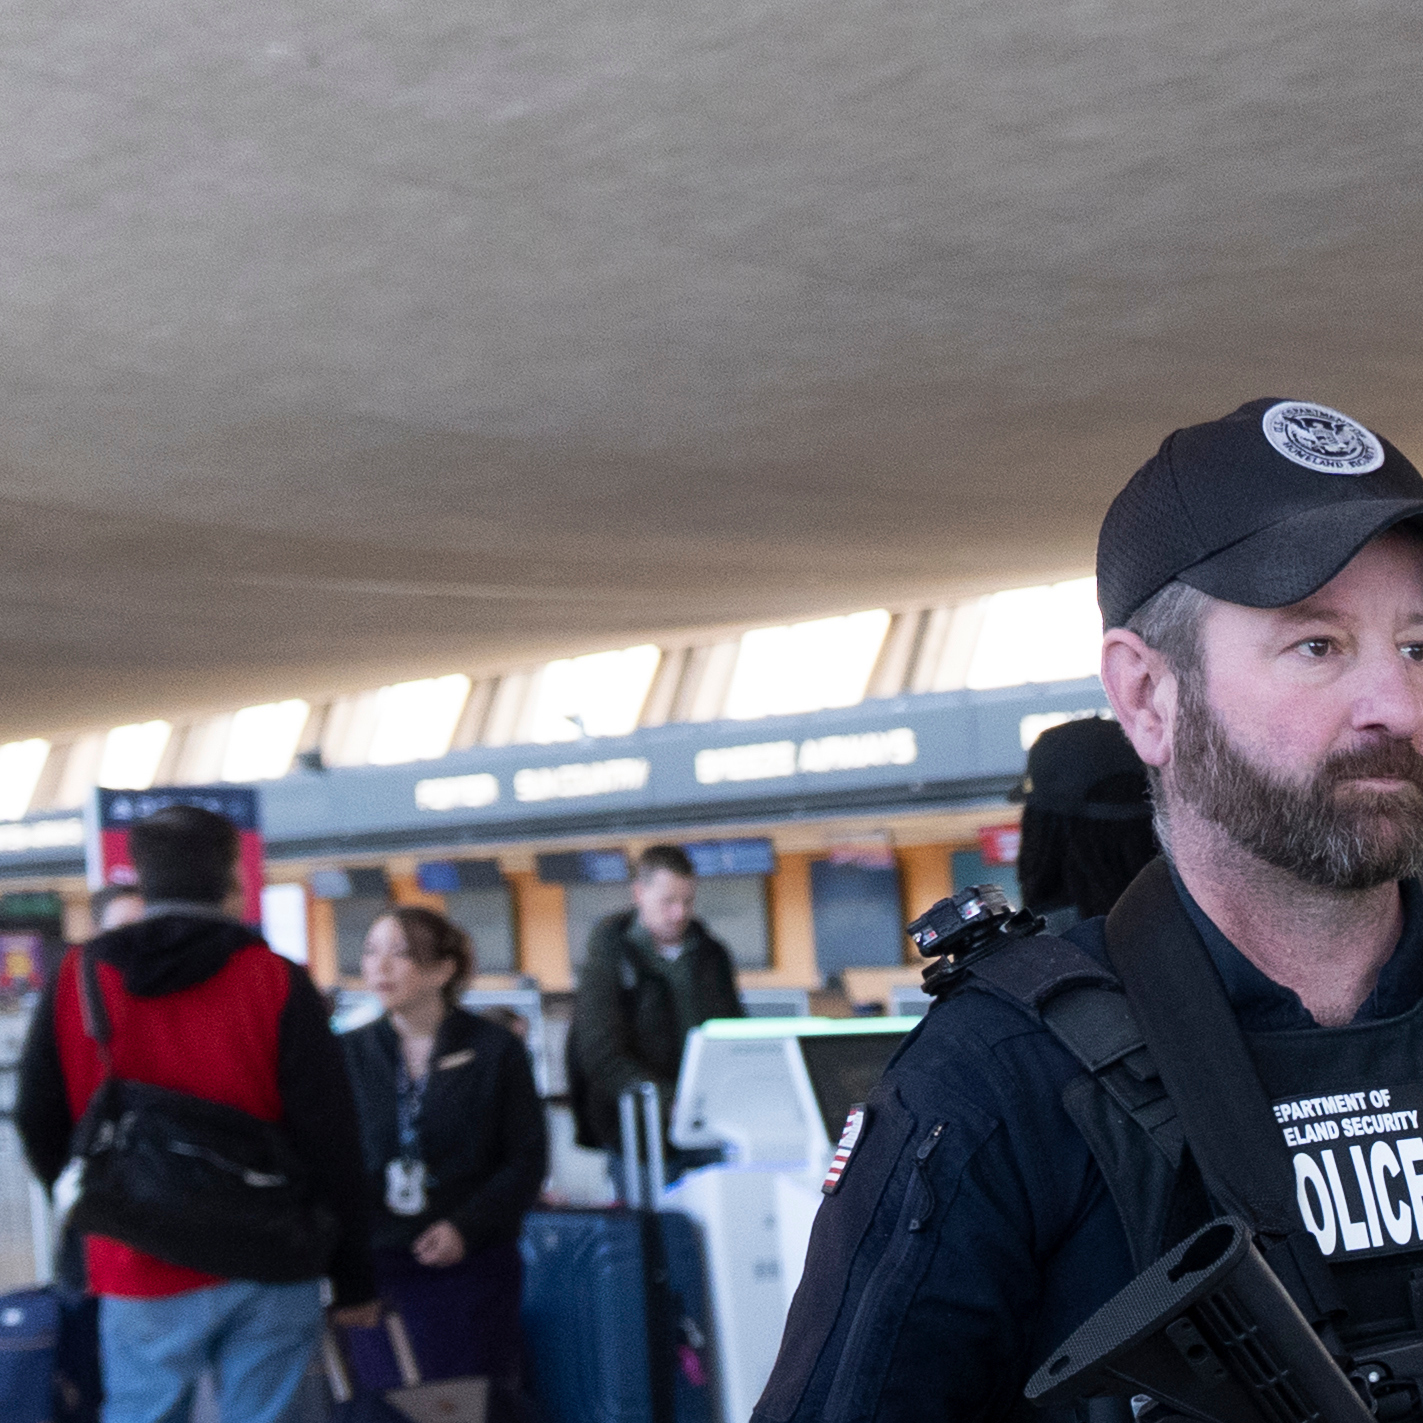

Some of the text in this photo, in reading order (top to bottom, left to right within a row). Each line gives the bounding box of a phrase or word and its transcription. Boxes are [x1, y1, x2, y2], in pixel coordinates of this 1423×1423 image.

[1273, 1089, 1391, 1123] EPARTMENT OF
[1283, 1110, 1419, 1147] ELAND SECURITY
